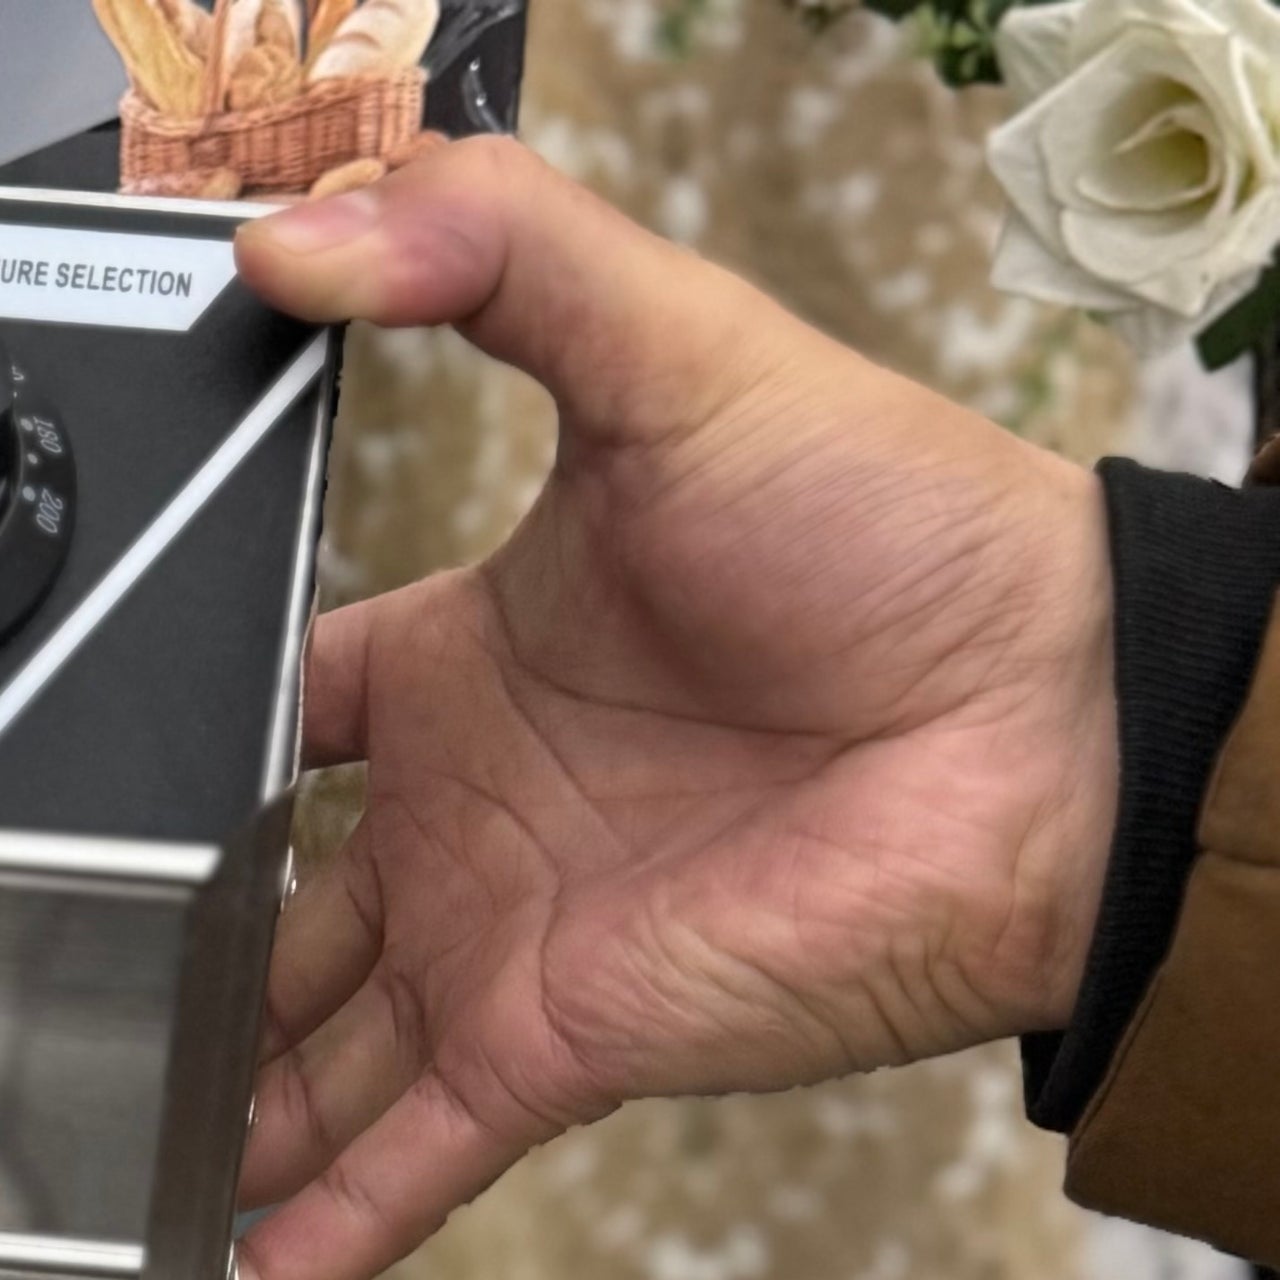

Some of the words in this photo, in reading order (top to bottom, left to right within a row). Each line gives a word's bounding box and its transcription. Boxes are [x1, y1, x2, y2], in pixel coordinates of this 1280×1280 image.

[55, 262, 194, 298] SELECTION
[33, 416, 63, 454] 180
[36, 487, 63, 534] 200
